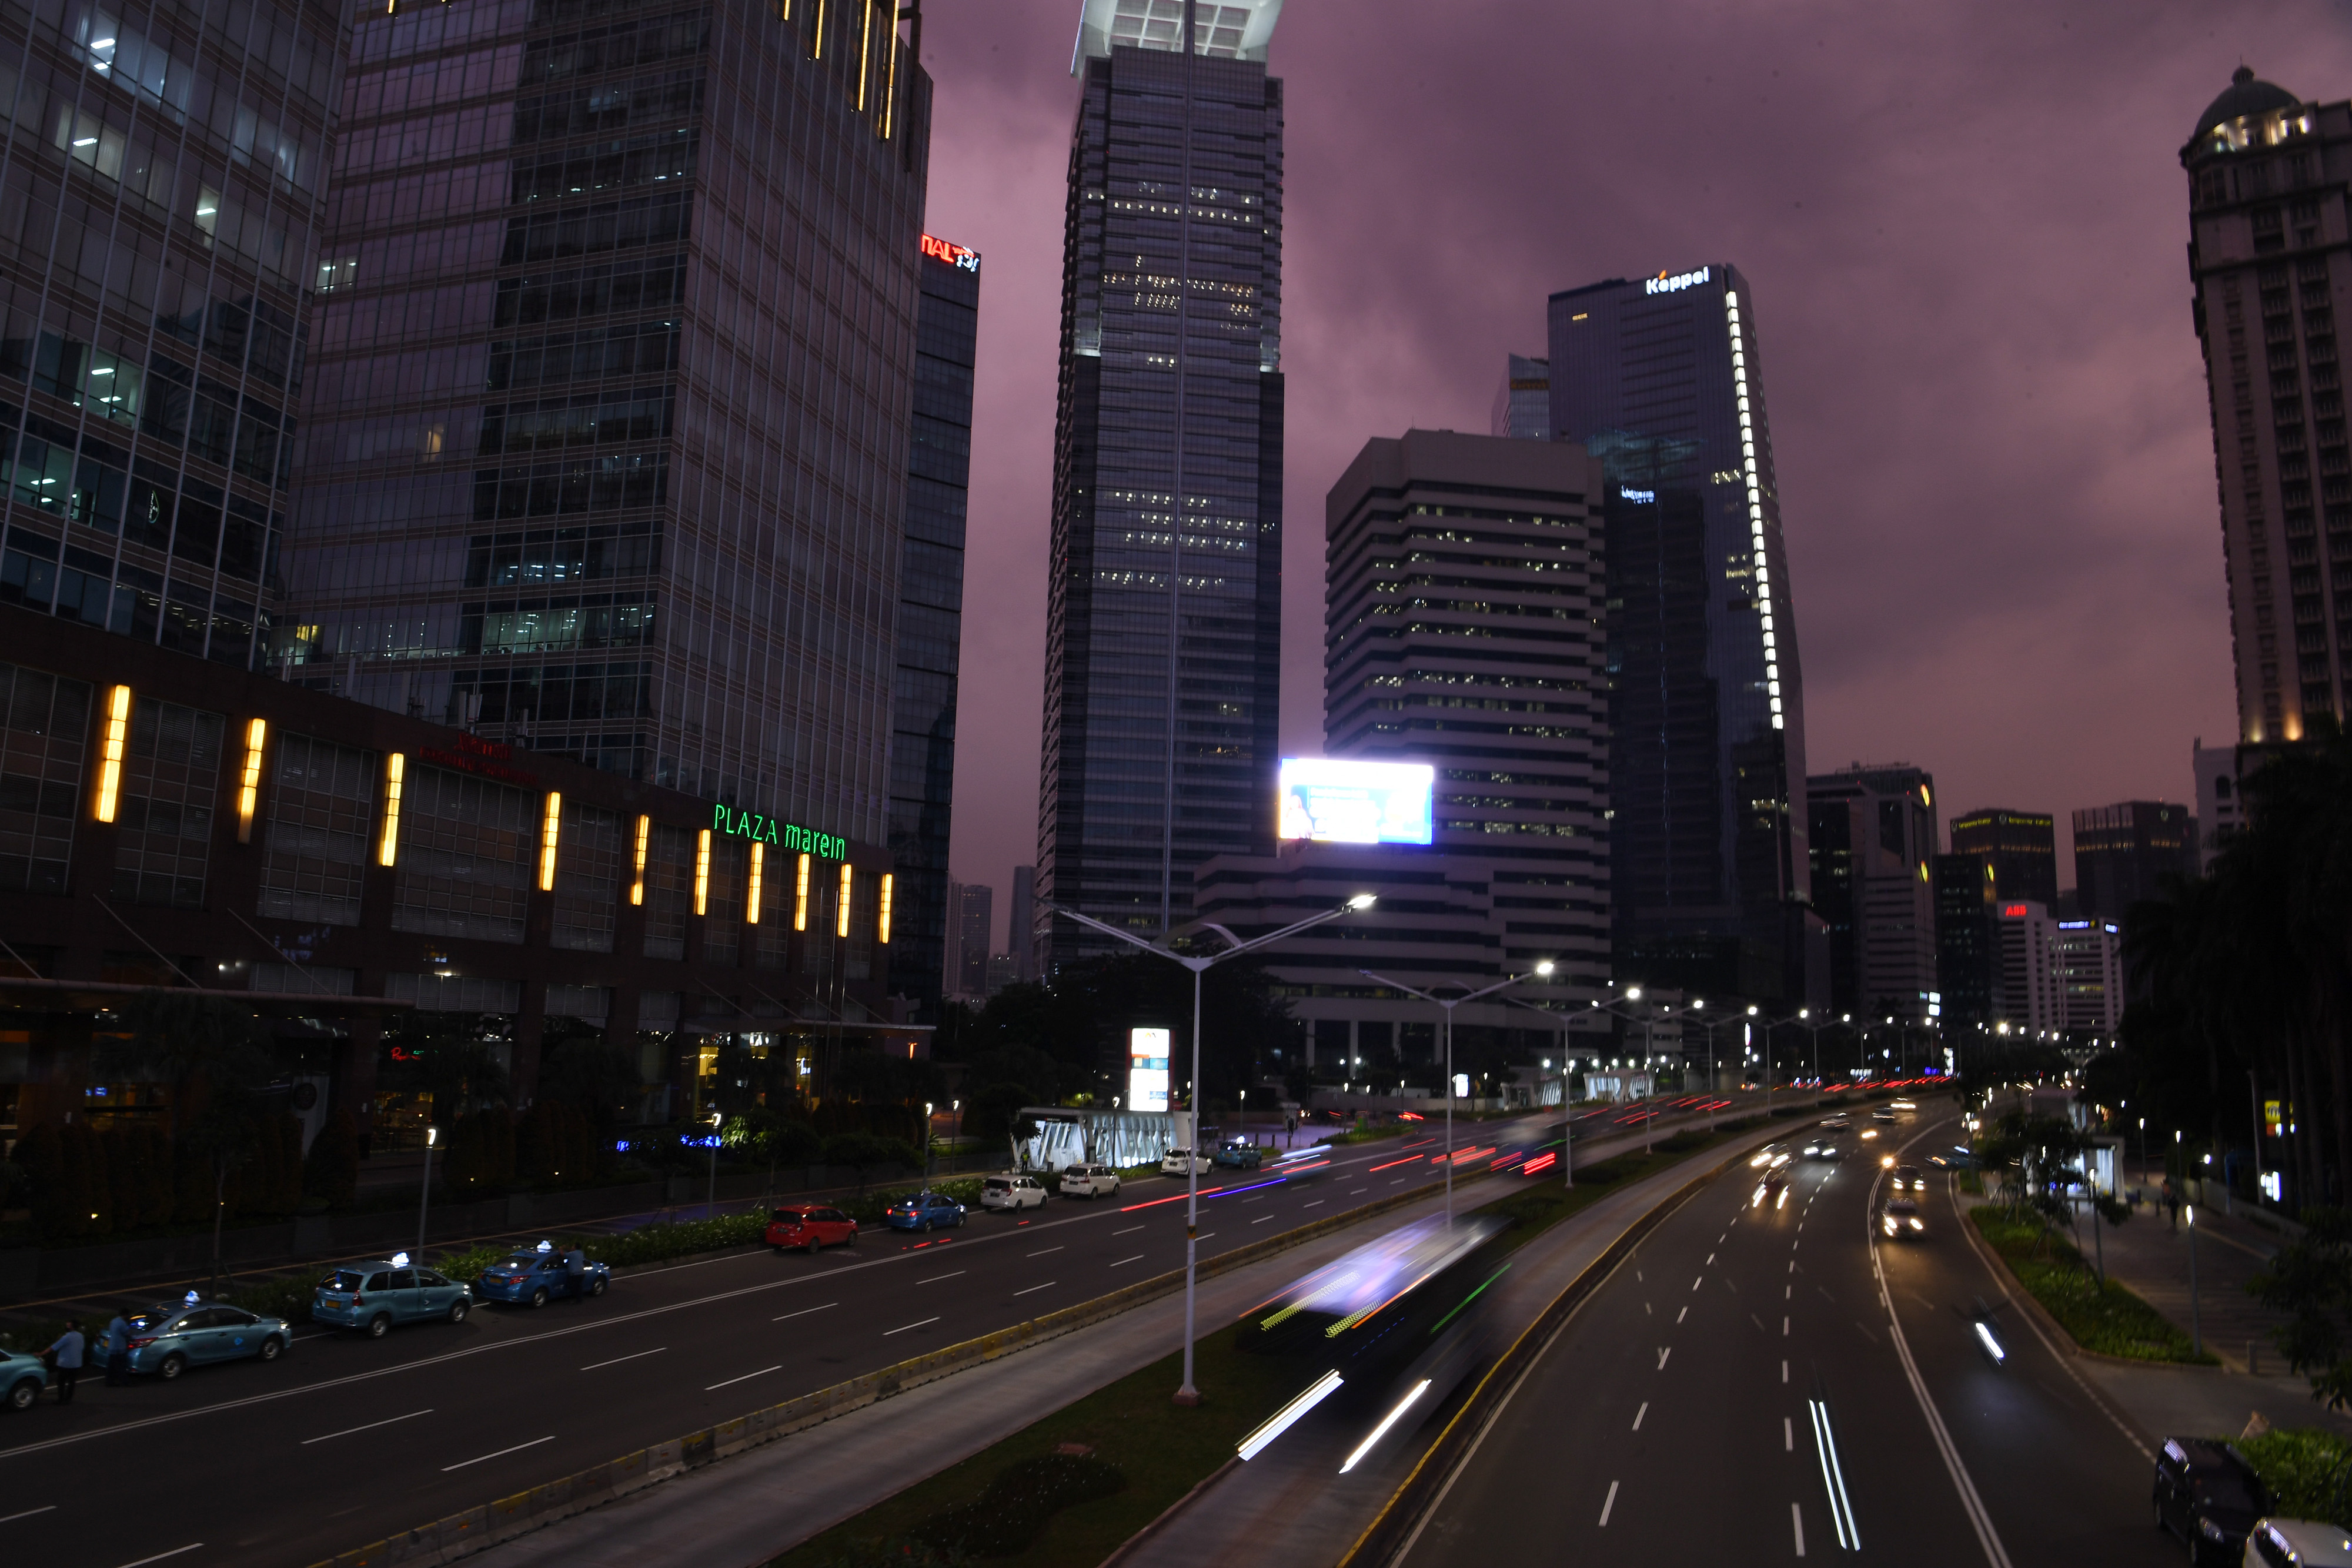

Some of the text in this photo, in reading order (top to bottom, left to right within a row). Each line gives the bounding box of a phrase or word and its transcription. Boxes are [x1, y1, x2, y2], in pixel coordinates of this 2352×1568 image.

[1646, 266, 1710, 295] Keppel
[713, 804, 846, 861] PLAZA marein
[2005, 905, 2027, 917] ABB
